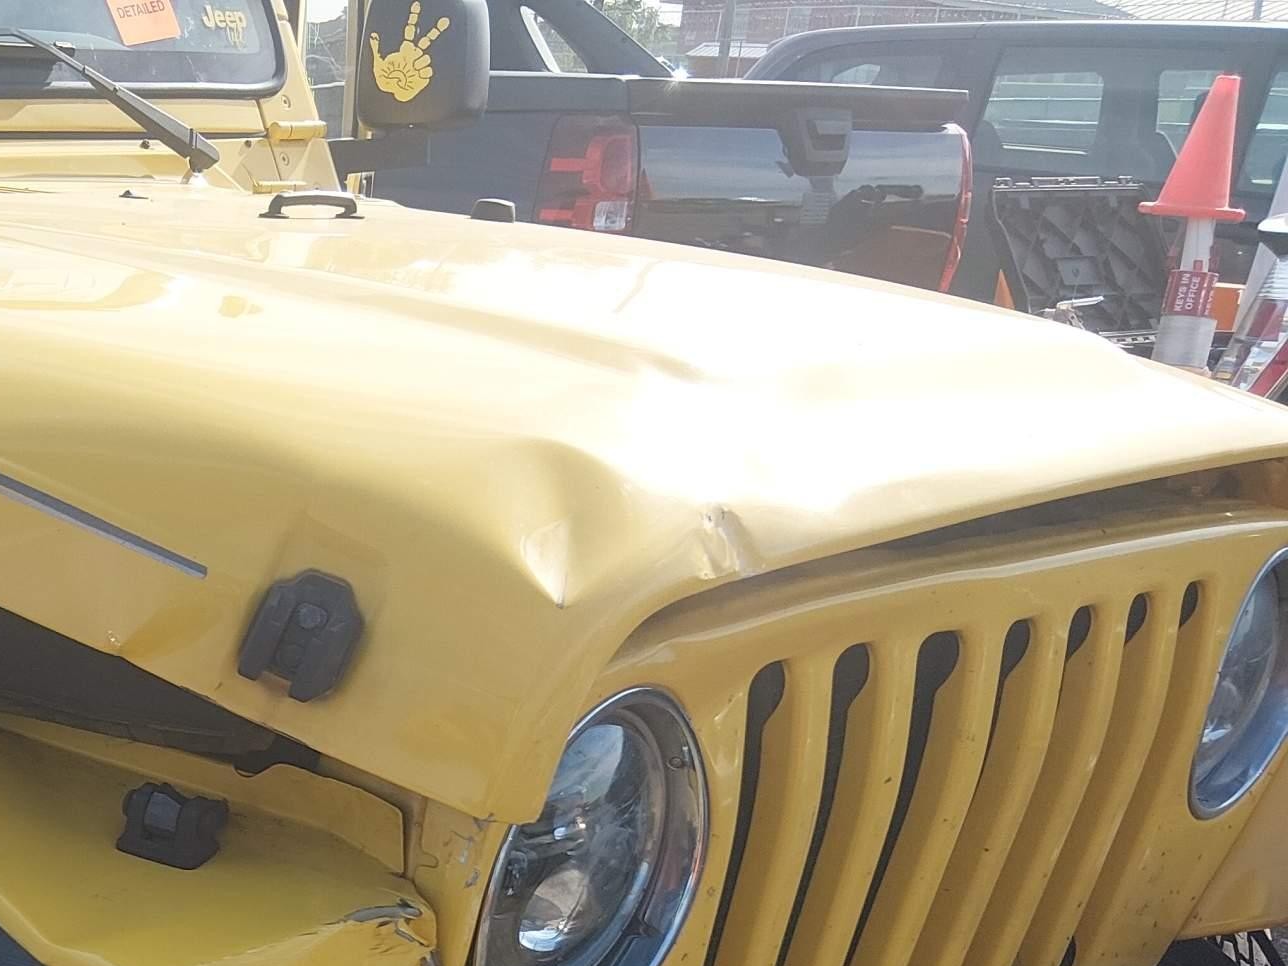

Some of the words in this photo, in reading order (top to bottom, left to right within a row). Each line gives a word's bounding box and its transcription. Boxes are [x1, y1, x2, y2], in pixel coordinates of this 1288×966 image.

[117, 1, 165, 18] DETAILED
[202, 4, 247, 31] Jeep
[1174, 286, 1187, 312] KEYS
[1181, 273, 1191, 284] IN
[1185, 276, 1200, 311] OFFICE
